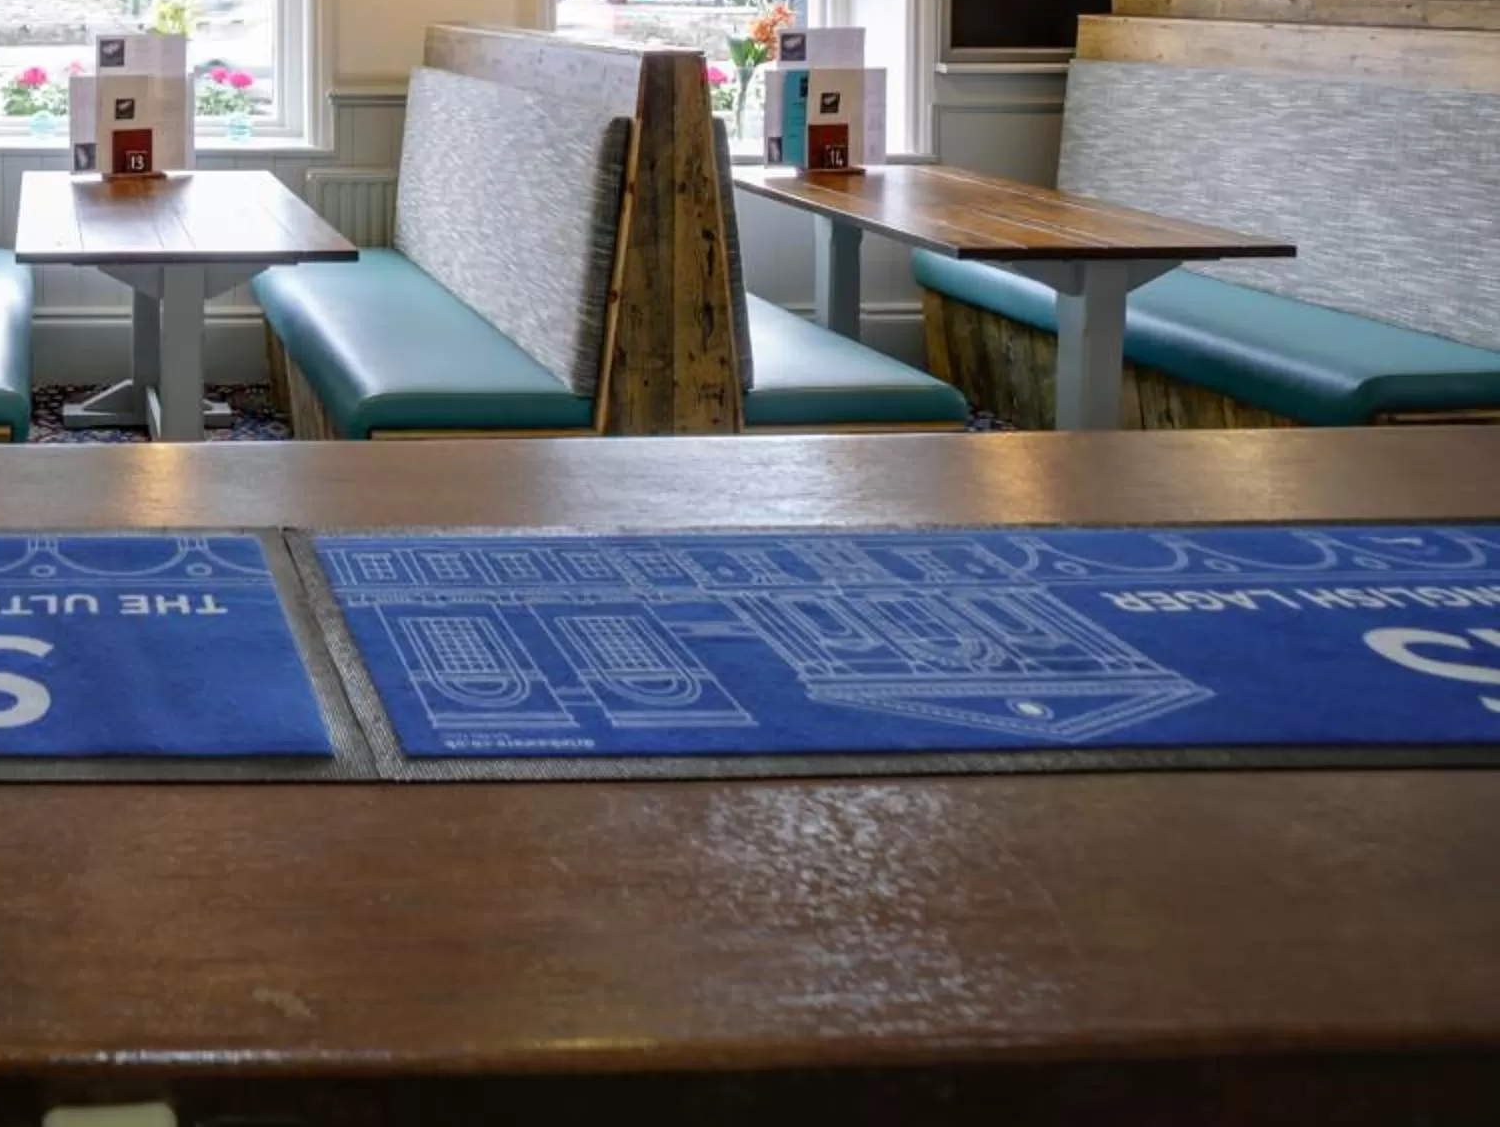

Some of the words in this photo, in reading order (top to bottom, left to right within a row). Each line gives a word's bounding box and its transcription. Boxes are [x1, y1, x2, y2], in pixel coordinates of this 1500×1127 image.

[131, 155, 145, 170] 13
[119, 593, 229, 615] THE
[1100, 587, 1301, 613] LAGER
